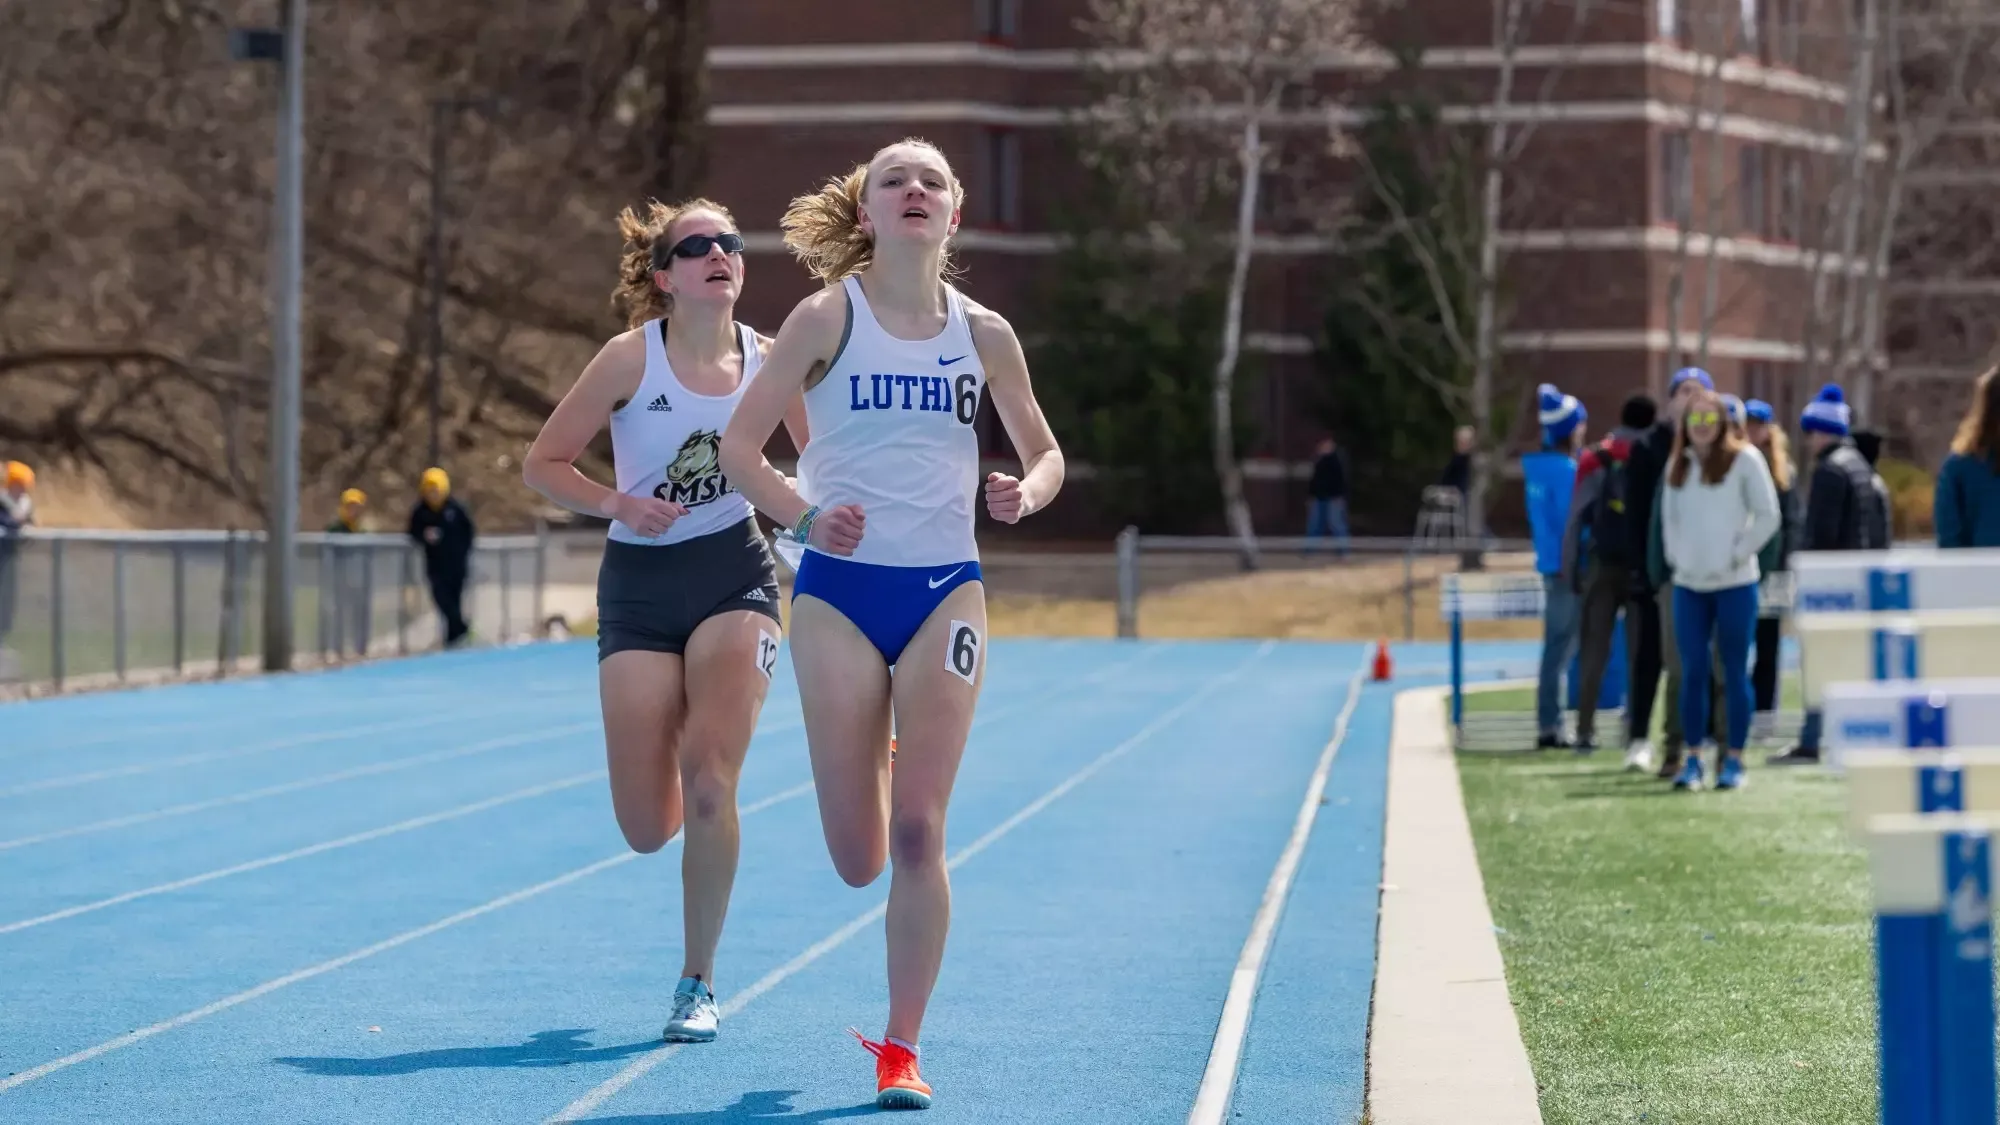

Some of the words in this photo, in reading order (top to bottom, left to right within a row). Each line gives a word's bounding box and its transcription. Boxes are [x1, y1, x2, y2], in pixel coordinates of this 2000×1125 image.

[955, 373, 977, 425] 6
[760, 637, 777, 679] 12
[952, 626, 977, 677] 6
